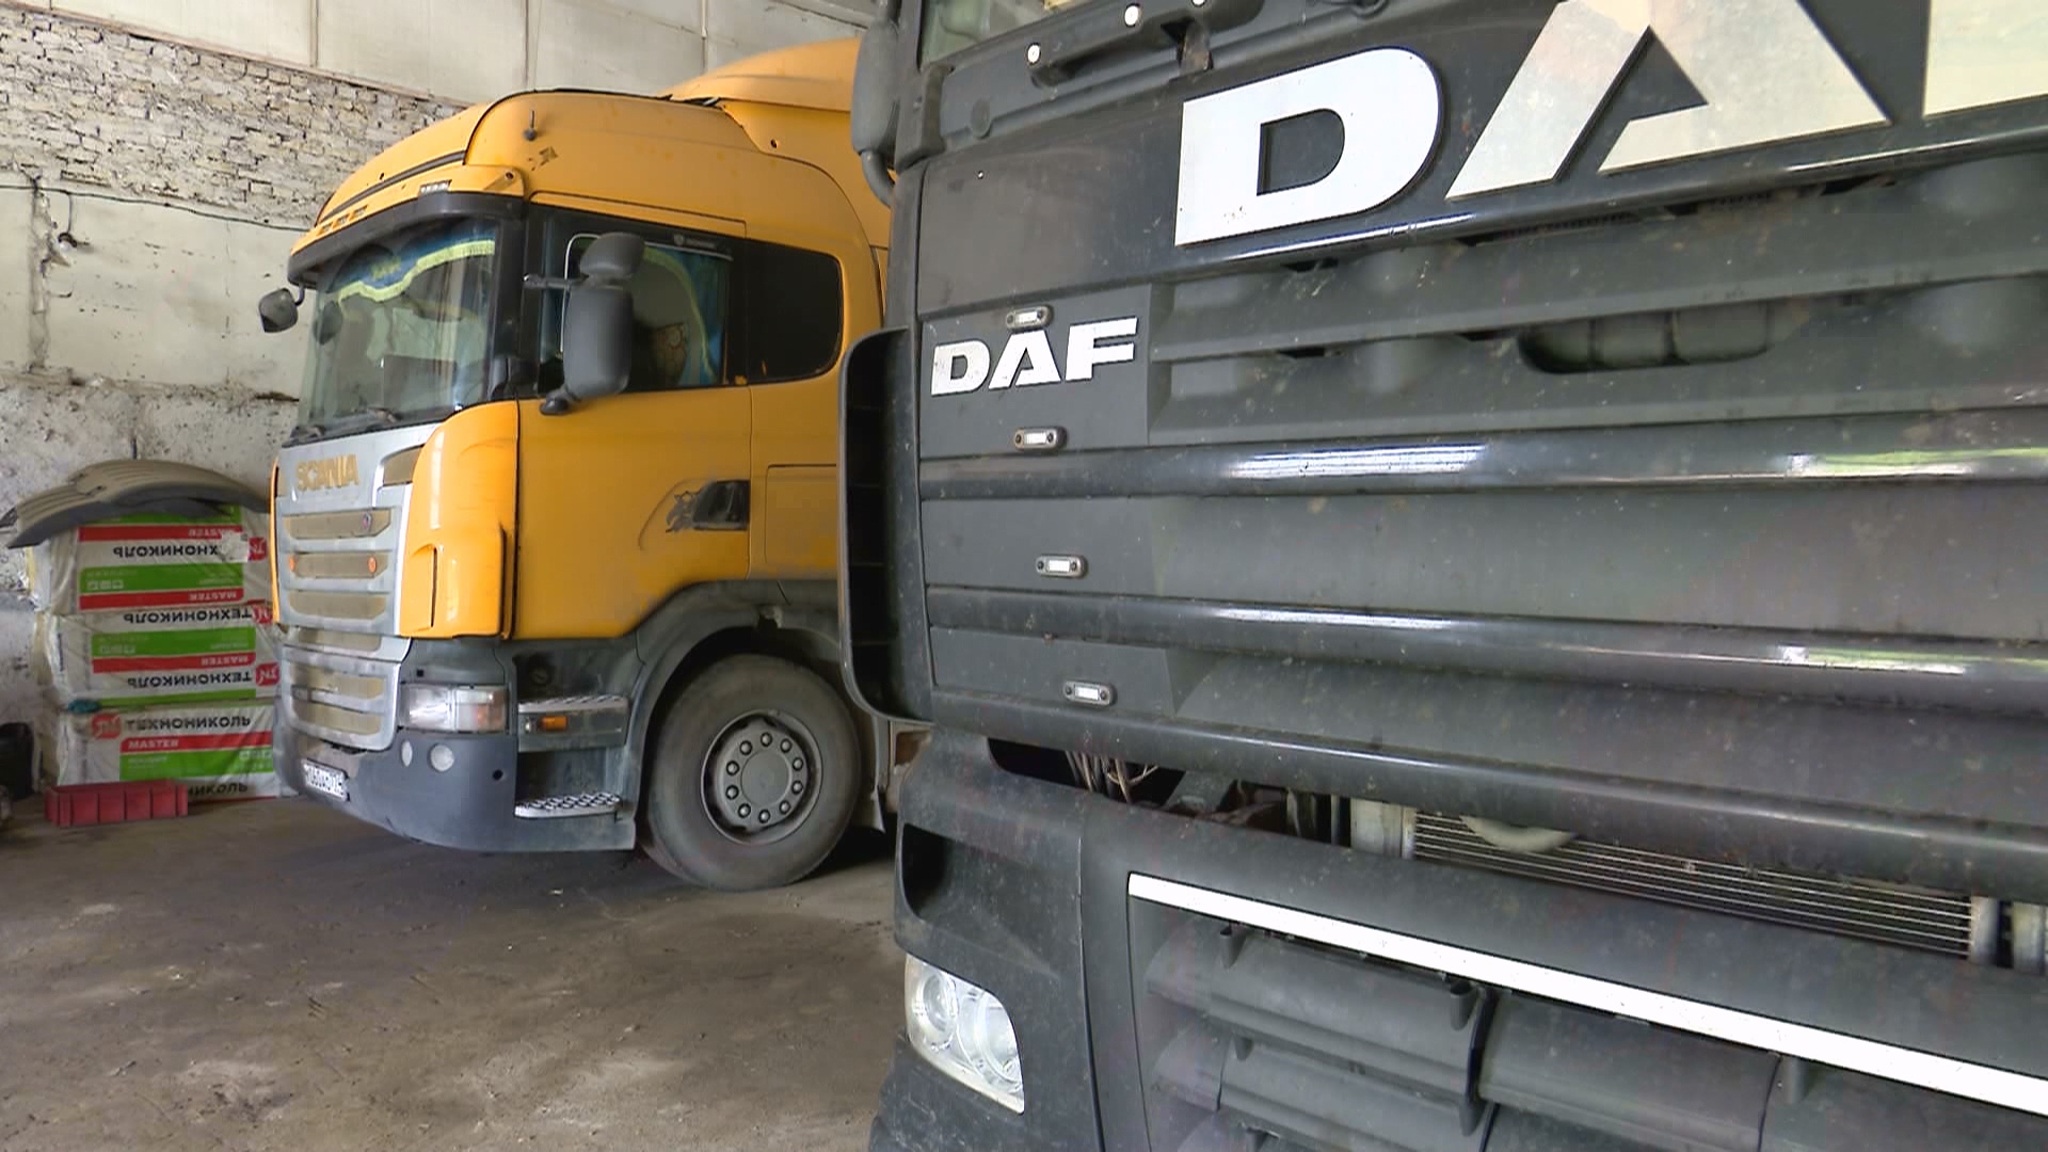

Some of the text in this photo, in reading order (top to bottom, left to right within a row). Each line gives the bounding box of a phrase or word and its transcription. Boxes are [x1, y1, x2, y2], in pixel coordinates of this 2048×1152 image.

[931, 317, 1138, 396] DAF
[296, 454, 360, 491] SCANIA
[113, 545, 219, 558] ХНОНИКОЛЬ
[189, 592, 237, 600] MASTER
[124, 608, 252, 623] ТЕХНОНИКОЛЬ
[201, 655, 249, 666] MASTER
[128, 671, 252, 688] ТЕХНОНИКОЛЬ
[126, 715, 251, 731] ТЕХНОНИКОЛЬ
[128, 739, 179, 749] MASTER
